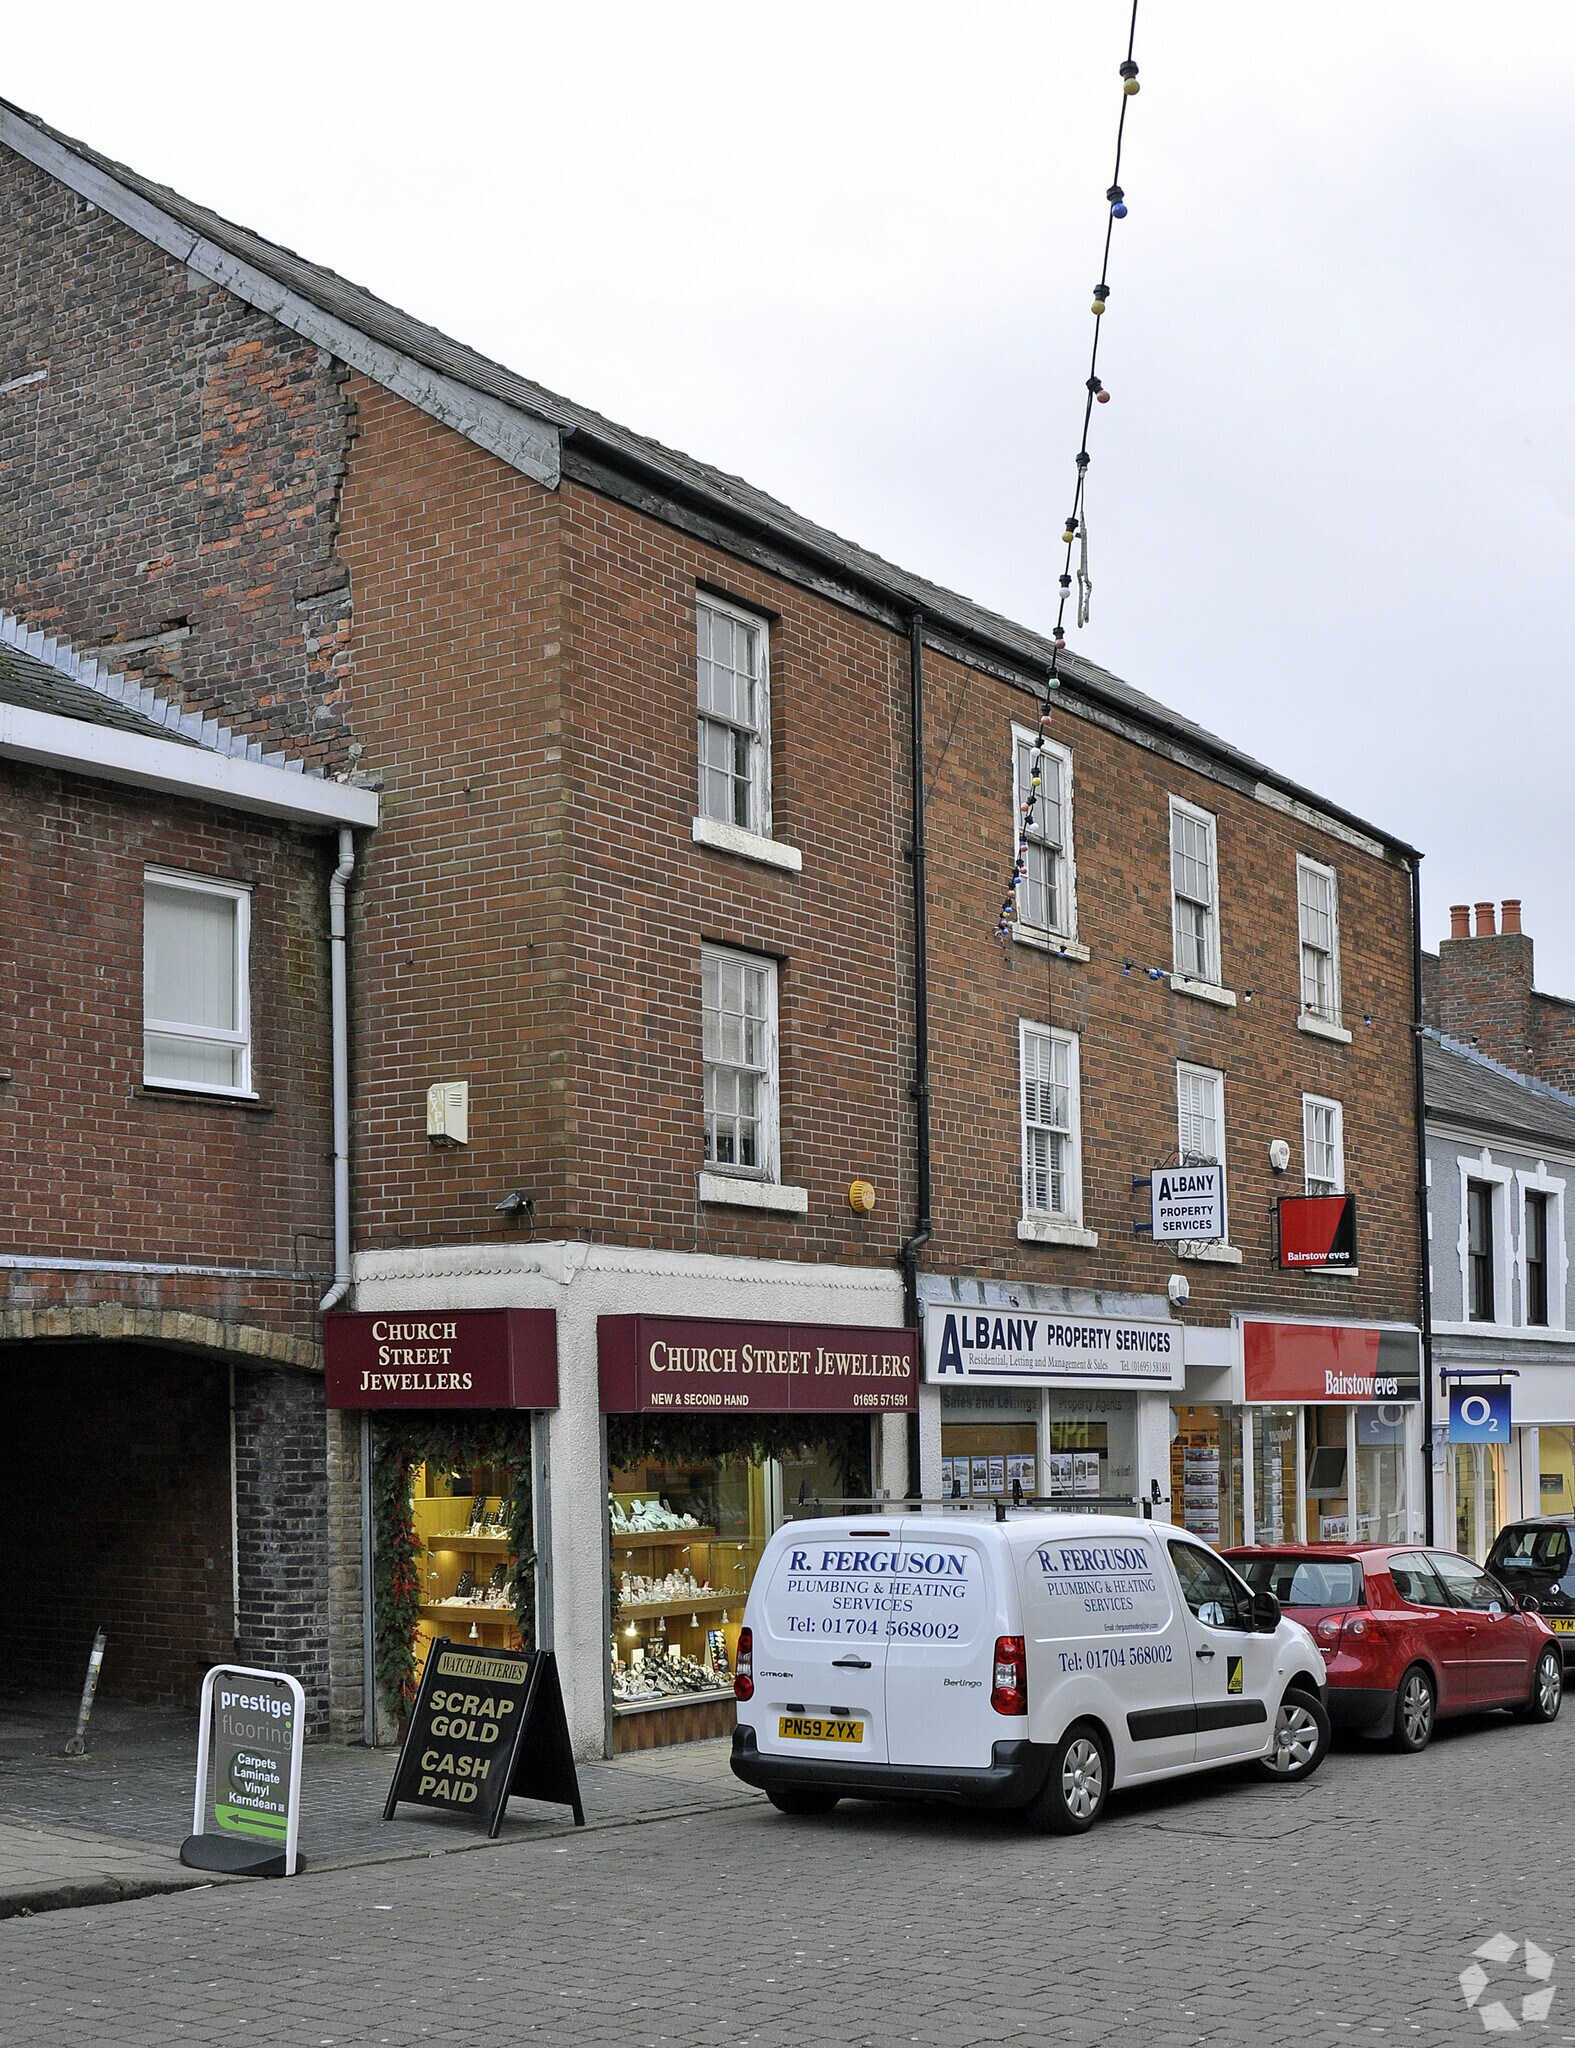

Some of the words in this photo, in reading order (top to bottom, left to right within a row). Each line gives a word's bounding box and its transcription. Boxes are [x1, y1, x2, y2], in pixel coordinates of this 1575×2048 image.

[1158, 1174, 1214, 1201] ALBANY
[1160, 1205, 1214, 1218] PROPERTY
[1162, 1219, 1212, 1231] SERVICES
[1287, 1252, 1328, 1261] Bairstow
[1328, 1251, 1350, 1260] eves
[371, 1321, 458, 1341] CHURCH
[937, 1313, 1038, 1375] ALBANY
[1047, 1324, 1111, 1350] PROPERTY
[1116, 1329, 1171, 1353] SERVICES
[378, 1345, 452, 1366] STREET
[649, 1340, 738, 1373] CHURCH
[742, 1343, 811, 1375] STREET
[815, 1347, 911, 1378] JEWELLERS
[968, 1352, 1008, 1369] Residential,
[1009, 1354, 1034, 1370] Letting
[1034, 1356, 1046, 1368] and
[1047, 1356, 1087, 1372] Management
[1087, 1359, 1093, 1369] &
[1093, 1358, 1108, 1370] Sales
[1131, 1361, 1151, 1373] (01695)
[360, 1370, 473, 1391] JEWELLERS
[1324, 1370, 1375, 1395] Bairstow
[1375, 1377, 1398, 1395] eves
[651, 1393, 673, 1405] NEW
[675, 1393, 682, 1405] &
[683, 1393, 722, 1406] SECOND
[724, 1394, 749, 1406] HAND
[853, 1394, 878, 1406] 01695
[880, 1394, 909, 1406] 571591
[943, 1394, 972, 1409] Sales
[975, 1394, 995, 1409] and
[1461, 1395, 1499, 1432] O2
[789, 1550, 812, 1572] R.
[820, 1551, 968, 1575] FERGUSON
[1037, 1550, 1059, 1572] R.
[1059, 1548, 1149, 1571] FERGUSON
[787, 1580, 869, 1594] PLUMBING
[873, 1583, 885, 1594] &
[888, 1582, 966, 1598] HEATING
[1047, 1580, 1103, 1596] PLUMBING
[1105, 1581, 1113, 1593] &
[1113, 1579, 1156, 1593] HEATING
[832, 1596, 913, 1612] SERVICES
[1083, 1597, 1134, 1612] SERVICES
[787, 1616, 816, 1633] Tel:
[822, 1617, 879, 1635] 01704
[885, 1620, 959, 1640] 568002
[442, 1655, 473, 1675] WATCH
[474, 1660, 525, 1681] BATTERIES
[1058, 1651, 1083, 1672] Tel:
[1086, 1648, 1126, 1669] 01704
[1129, 1645, 1173, 1666] 568002
[943, 1678, 982, 1688] Berlingo
[221, 1691, 292, 1719] prestige
[429, 1690, 515, 1720] SCRAP
[222, 1714, 292, 1750] flooring
[430, 1715, 500, 1743] GOLD
[784, 1718, 822, 1737] PN59
[825, 1721, 857, 1740] ZYX
[237, 1753, 277, 1770] Carpets
[421, 1750, 491, 1779] CASH
[234, 1766, 280, 1784] Laminate
[244, 1781, 270, 1797] Vinyl
[418, 1775, 478, 1803] PAID
[228, 1792, 277, 1811] Karndean
